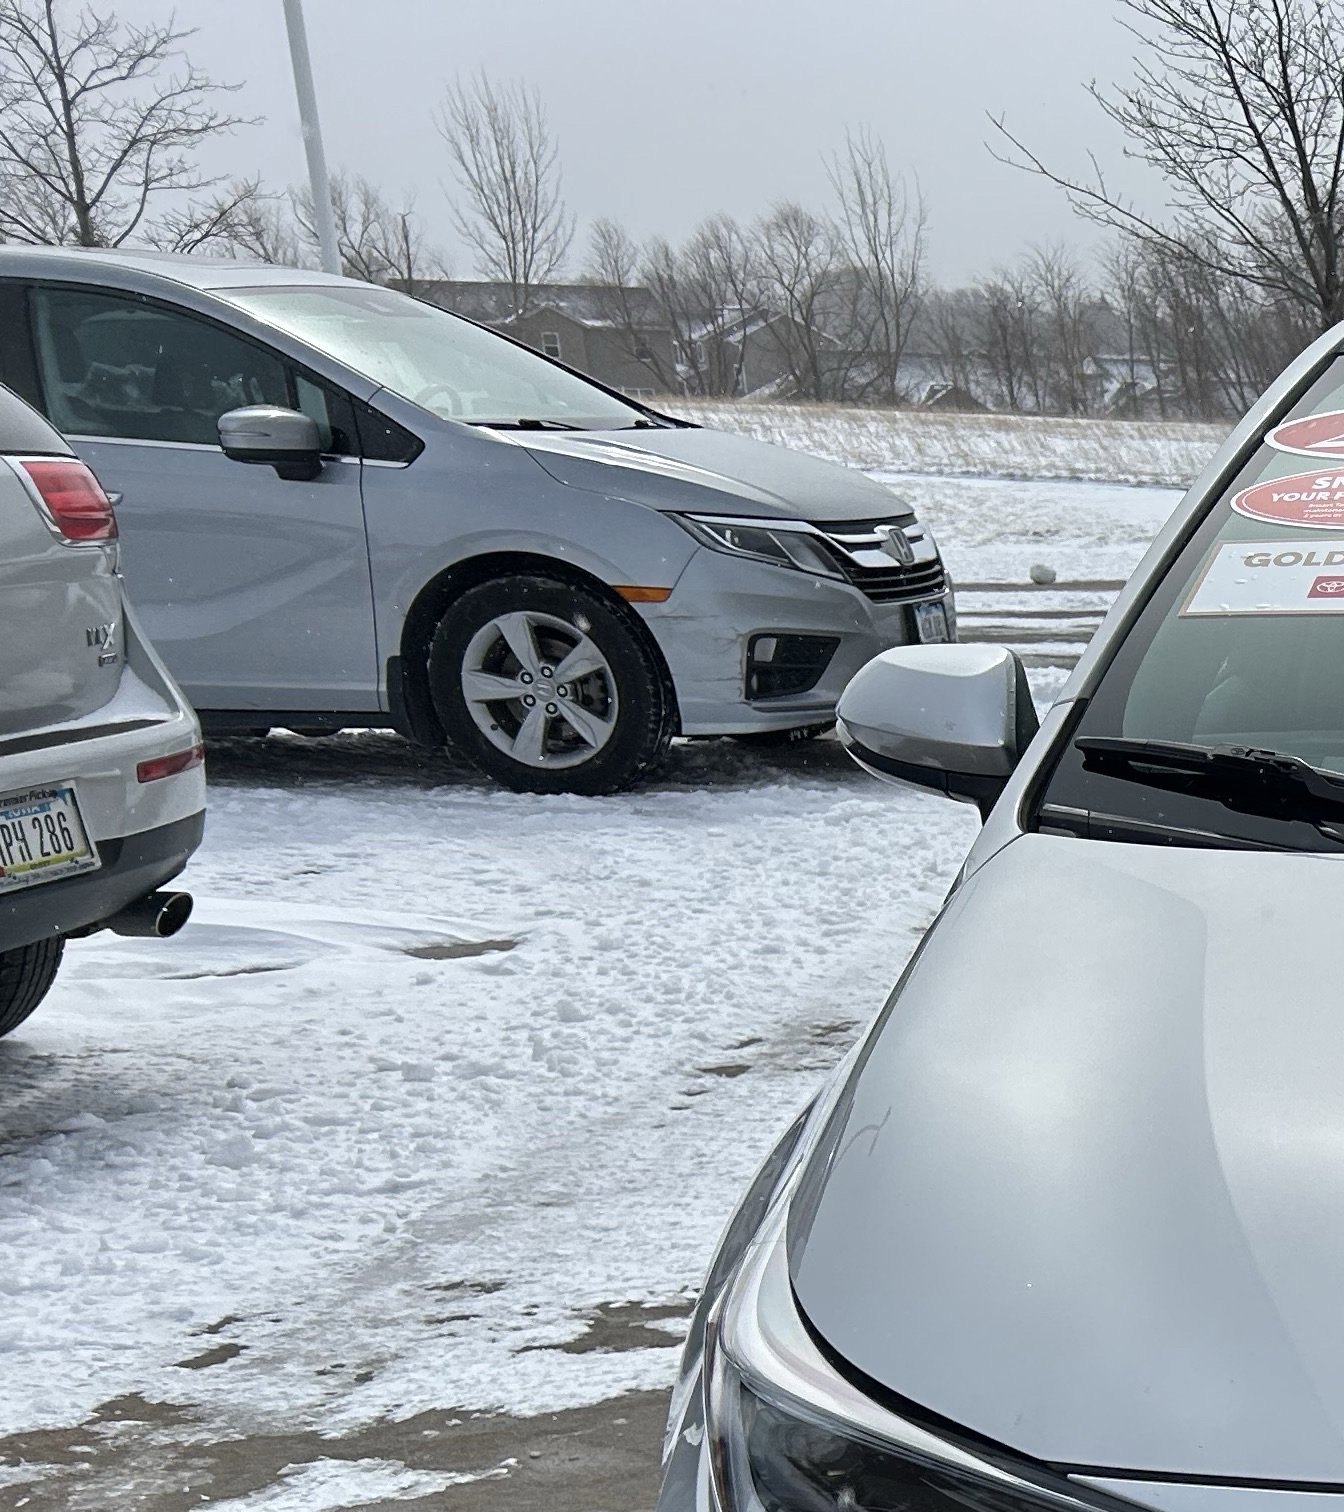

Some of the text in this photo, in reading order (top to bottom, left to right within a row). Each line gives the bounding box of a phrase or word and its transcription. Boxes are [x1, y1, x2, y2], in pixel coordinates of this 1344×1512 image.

[1271, 491, 1330, 503] YOUR
[0, 811, 74, 866] PH 286
